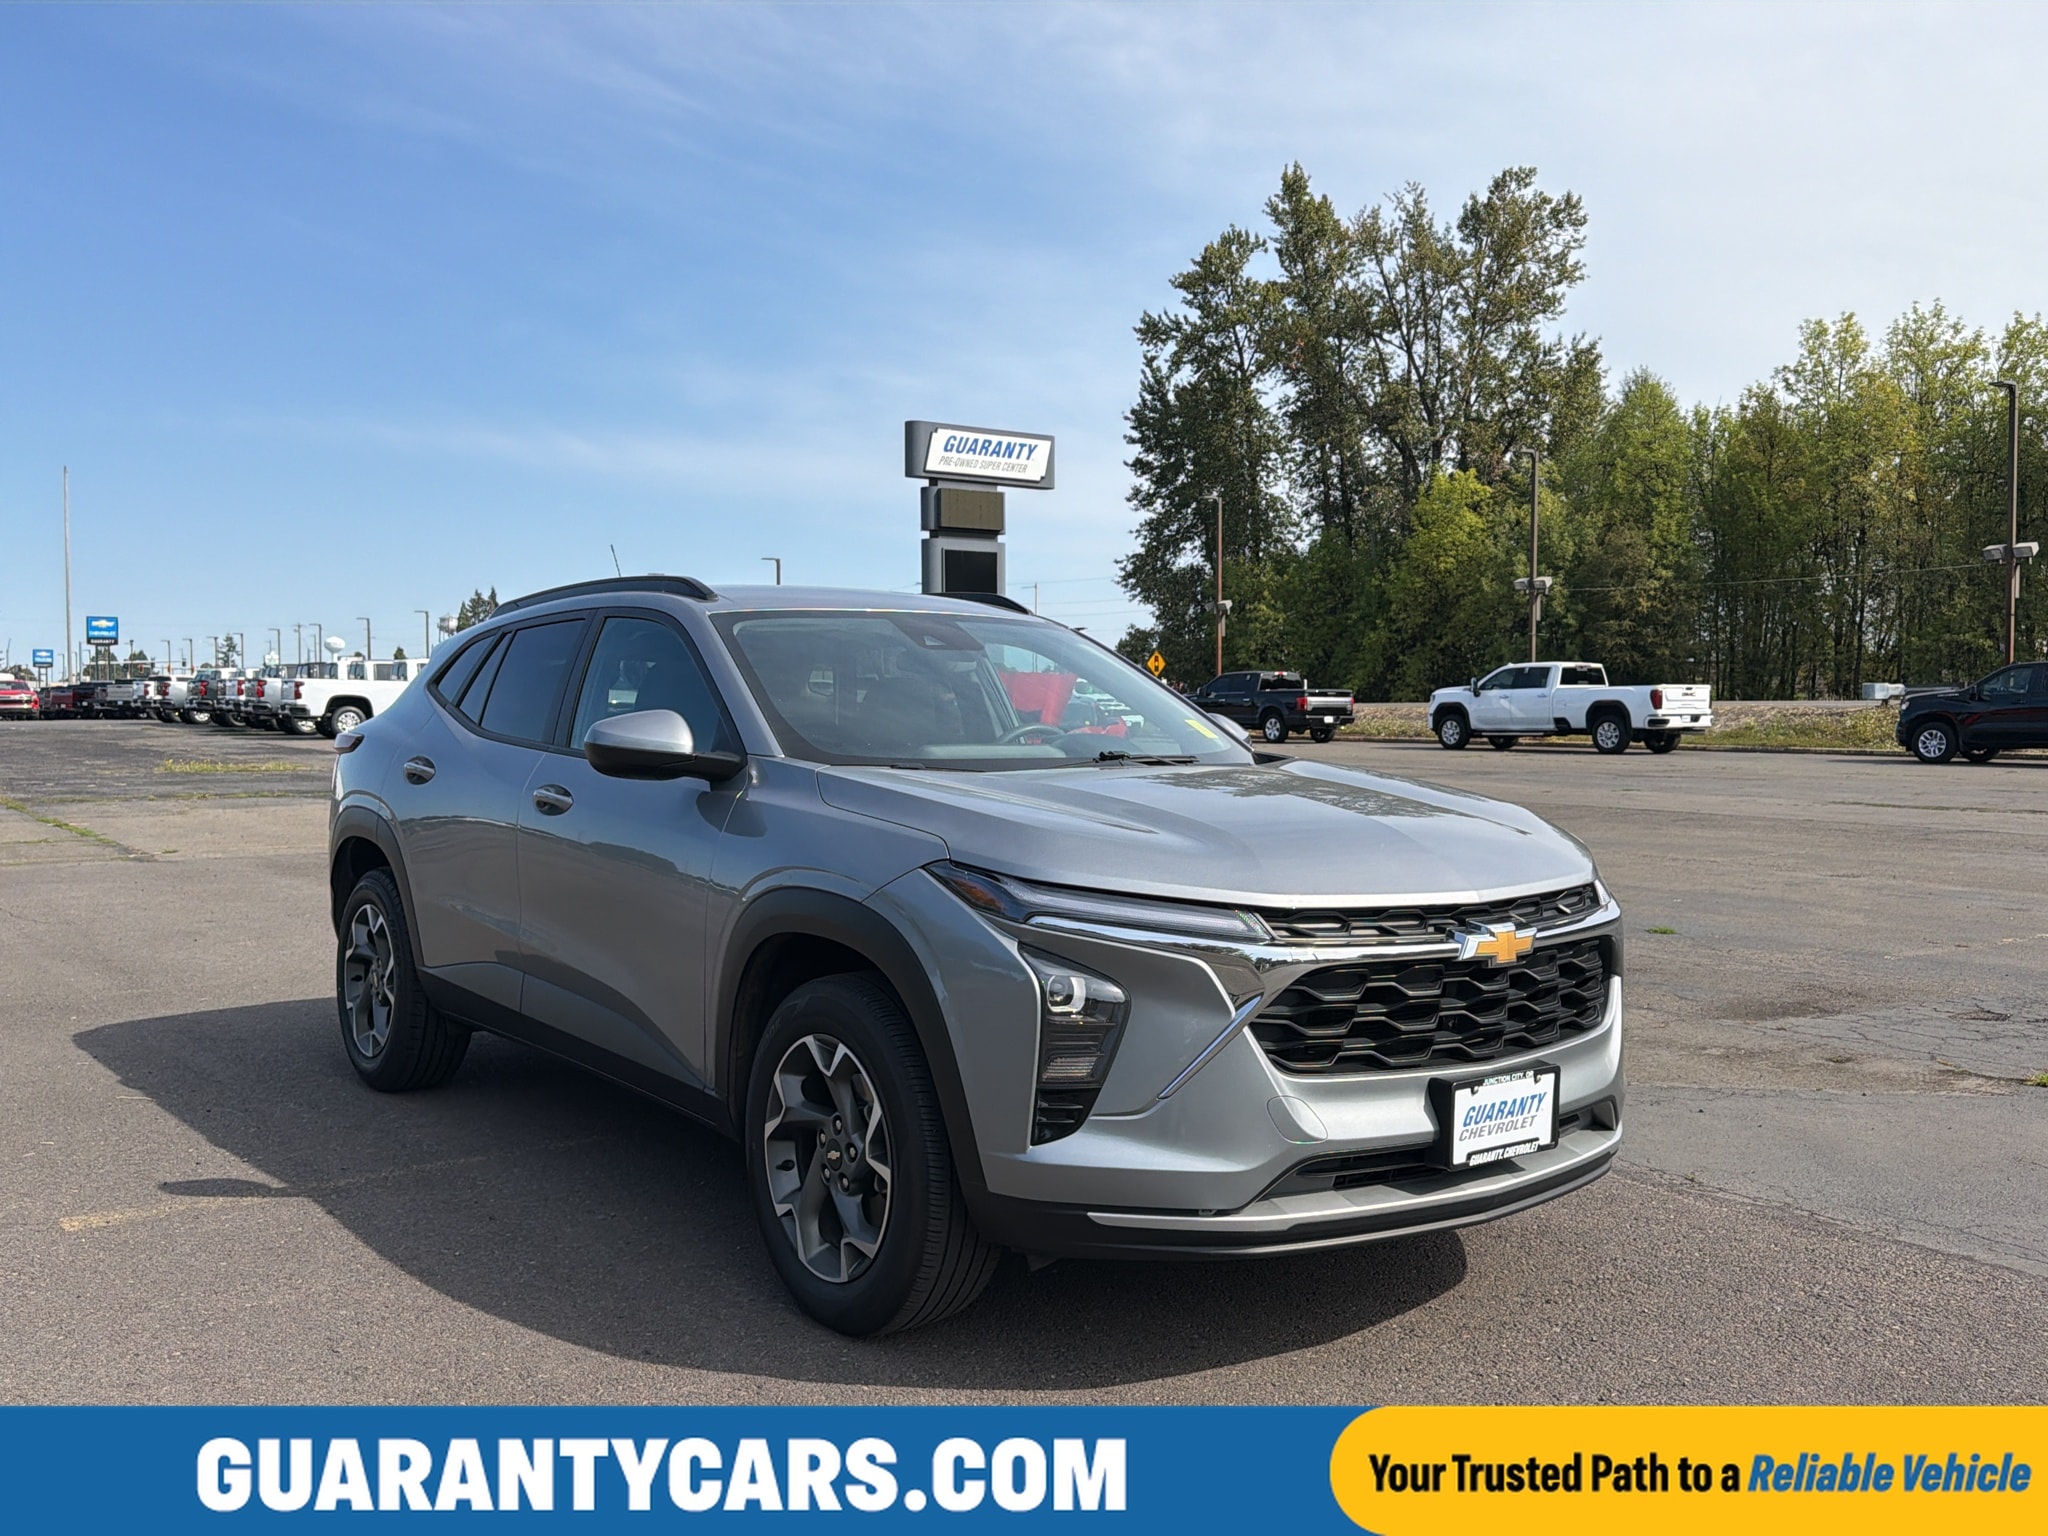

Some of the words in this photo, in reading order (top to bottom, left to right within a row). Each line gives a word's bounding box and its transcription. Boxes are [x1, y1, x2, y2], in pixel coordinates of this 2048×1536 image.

[943, 435, 1038, 461] GUARANTY
[938, 456, 978, 468] PRE-OWNED
[979, 461, 1001, 471] SUPER
[1002, 462, 1028, 473] CENTER
[1483, 1075, 1510, 1085] JUNCTION
[1463, 1092, 1547, 1128] GUARANTY
[1458, 1115, 1537, 1142] CHEVROLET
[1469, 1148, 1504, 1167] GUARANTY
[1503, 1140, 1539, 1159] CHEVROLET
